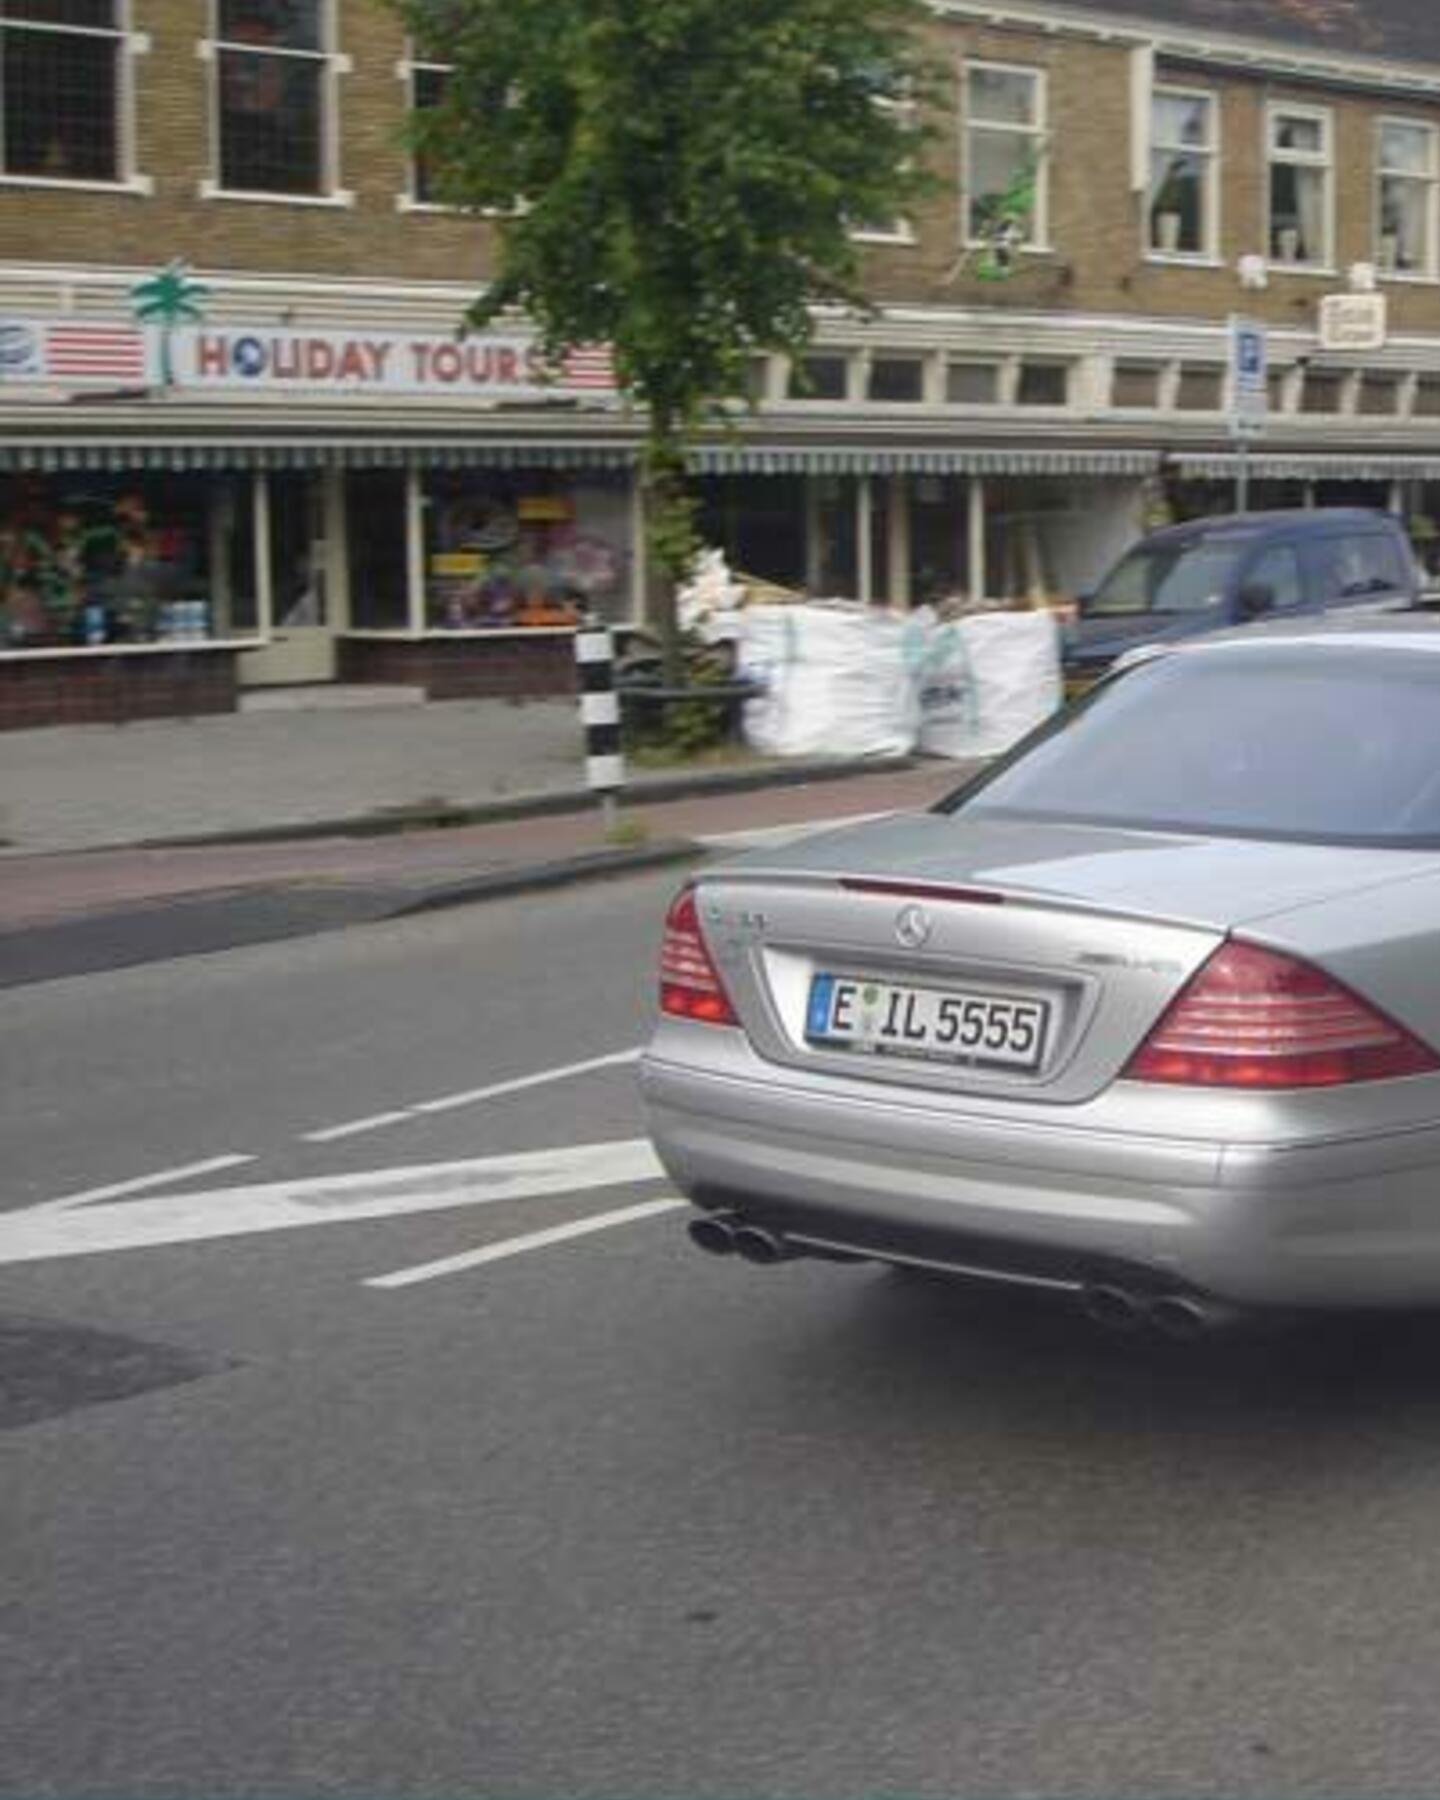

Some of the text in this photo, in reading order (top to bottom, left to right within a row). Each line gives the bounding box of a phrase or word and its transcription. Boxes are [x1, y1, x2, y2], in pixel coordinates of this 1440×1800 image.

[199, 336, 545, 384] HOLIDAY TOURS
[832, 985, 1037, 1052] E IL 5555
